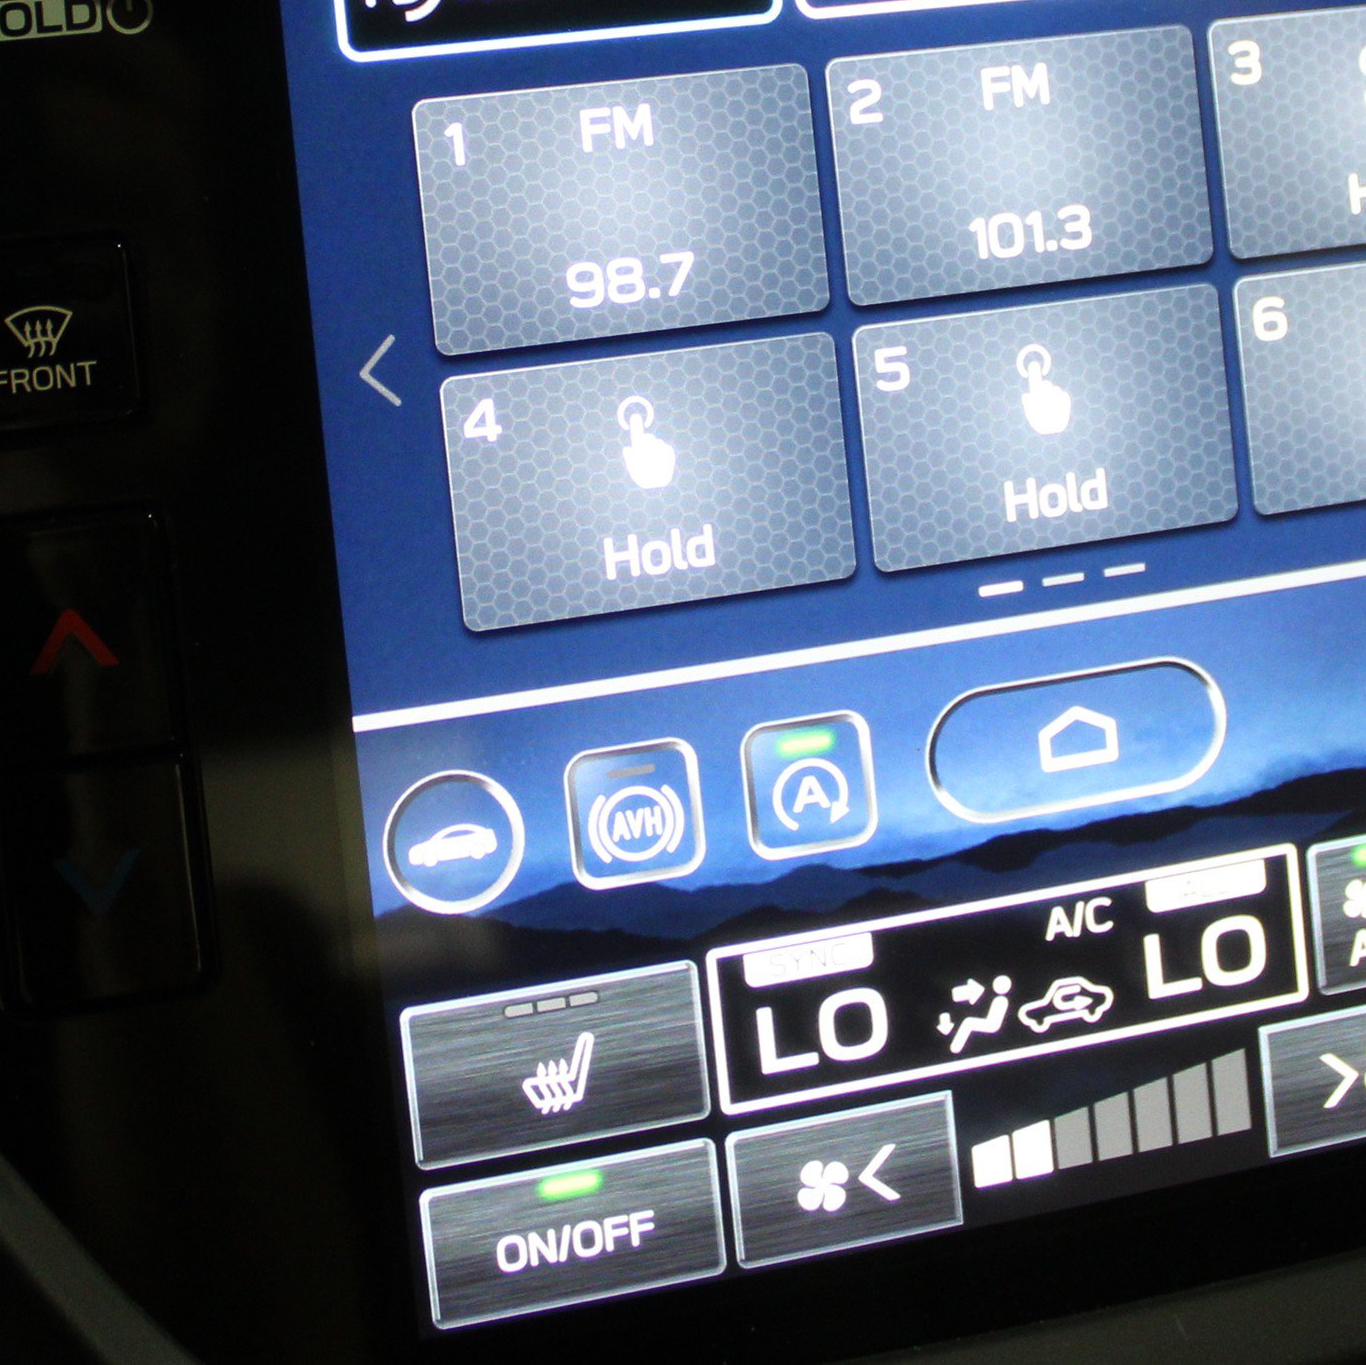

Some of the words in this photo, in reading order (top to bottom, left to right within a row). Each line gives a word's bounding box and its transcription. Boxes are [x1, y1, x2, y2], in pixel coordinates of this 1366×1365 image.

[980, 63, 1051, 111] FM
[1227, 40, 1263, 86] 3
[847, 80, 884, 125] 2
[443, 122, 466, 167] 1
[580, 104, 654, 153] FM
[968, 205, 1093, 260] 101.3
[566, 251, 696, 309] 98.7
[1251, 295, 1289, 343] 6
[874, 345, 911, 392] 5
[462, 399, 503, 443] 4
[1003, 467, 1109, 523] Hold
[602, 524, 717, 581] Hold
[611, 803, 664, 844] AVH
[1046, 897, 1114, 942] A/C
[1143, 914, 1267, 1000] LO
[756, 987, 888, 1076] LO
[496, 1210, 655, 1273] ON/OFF
